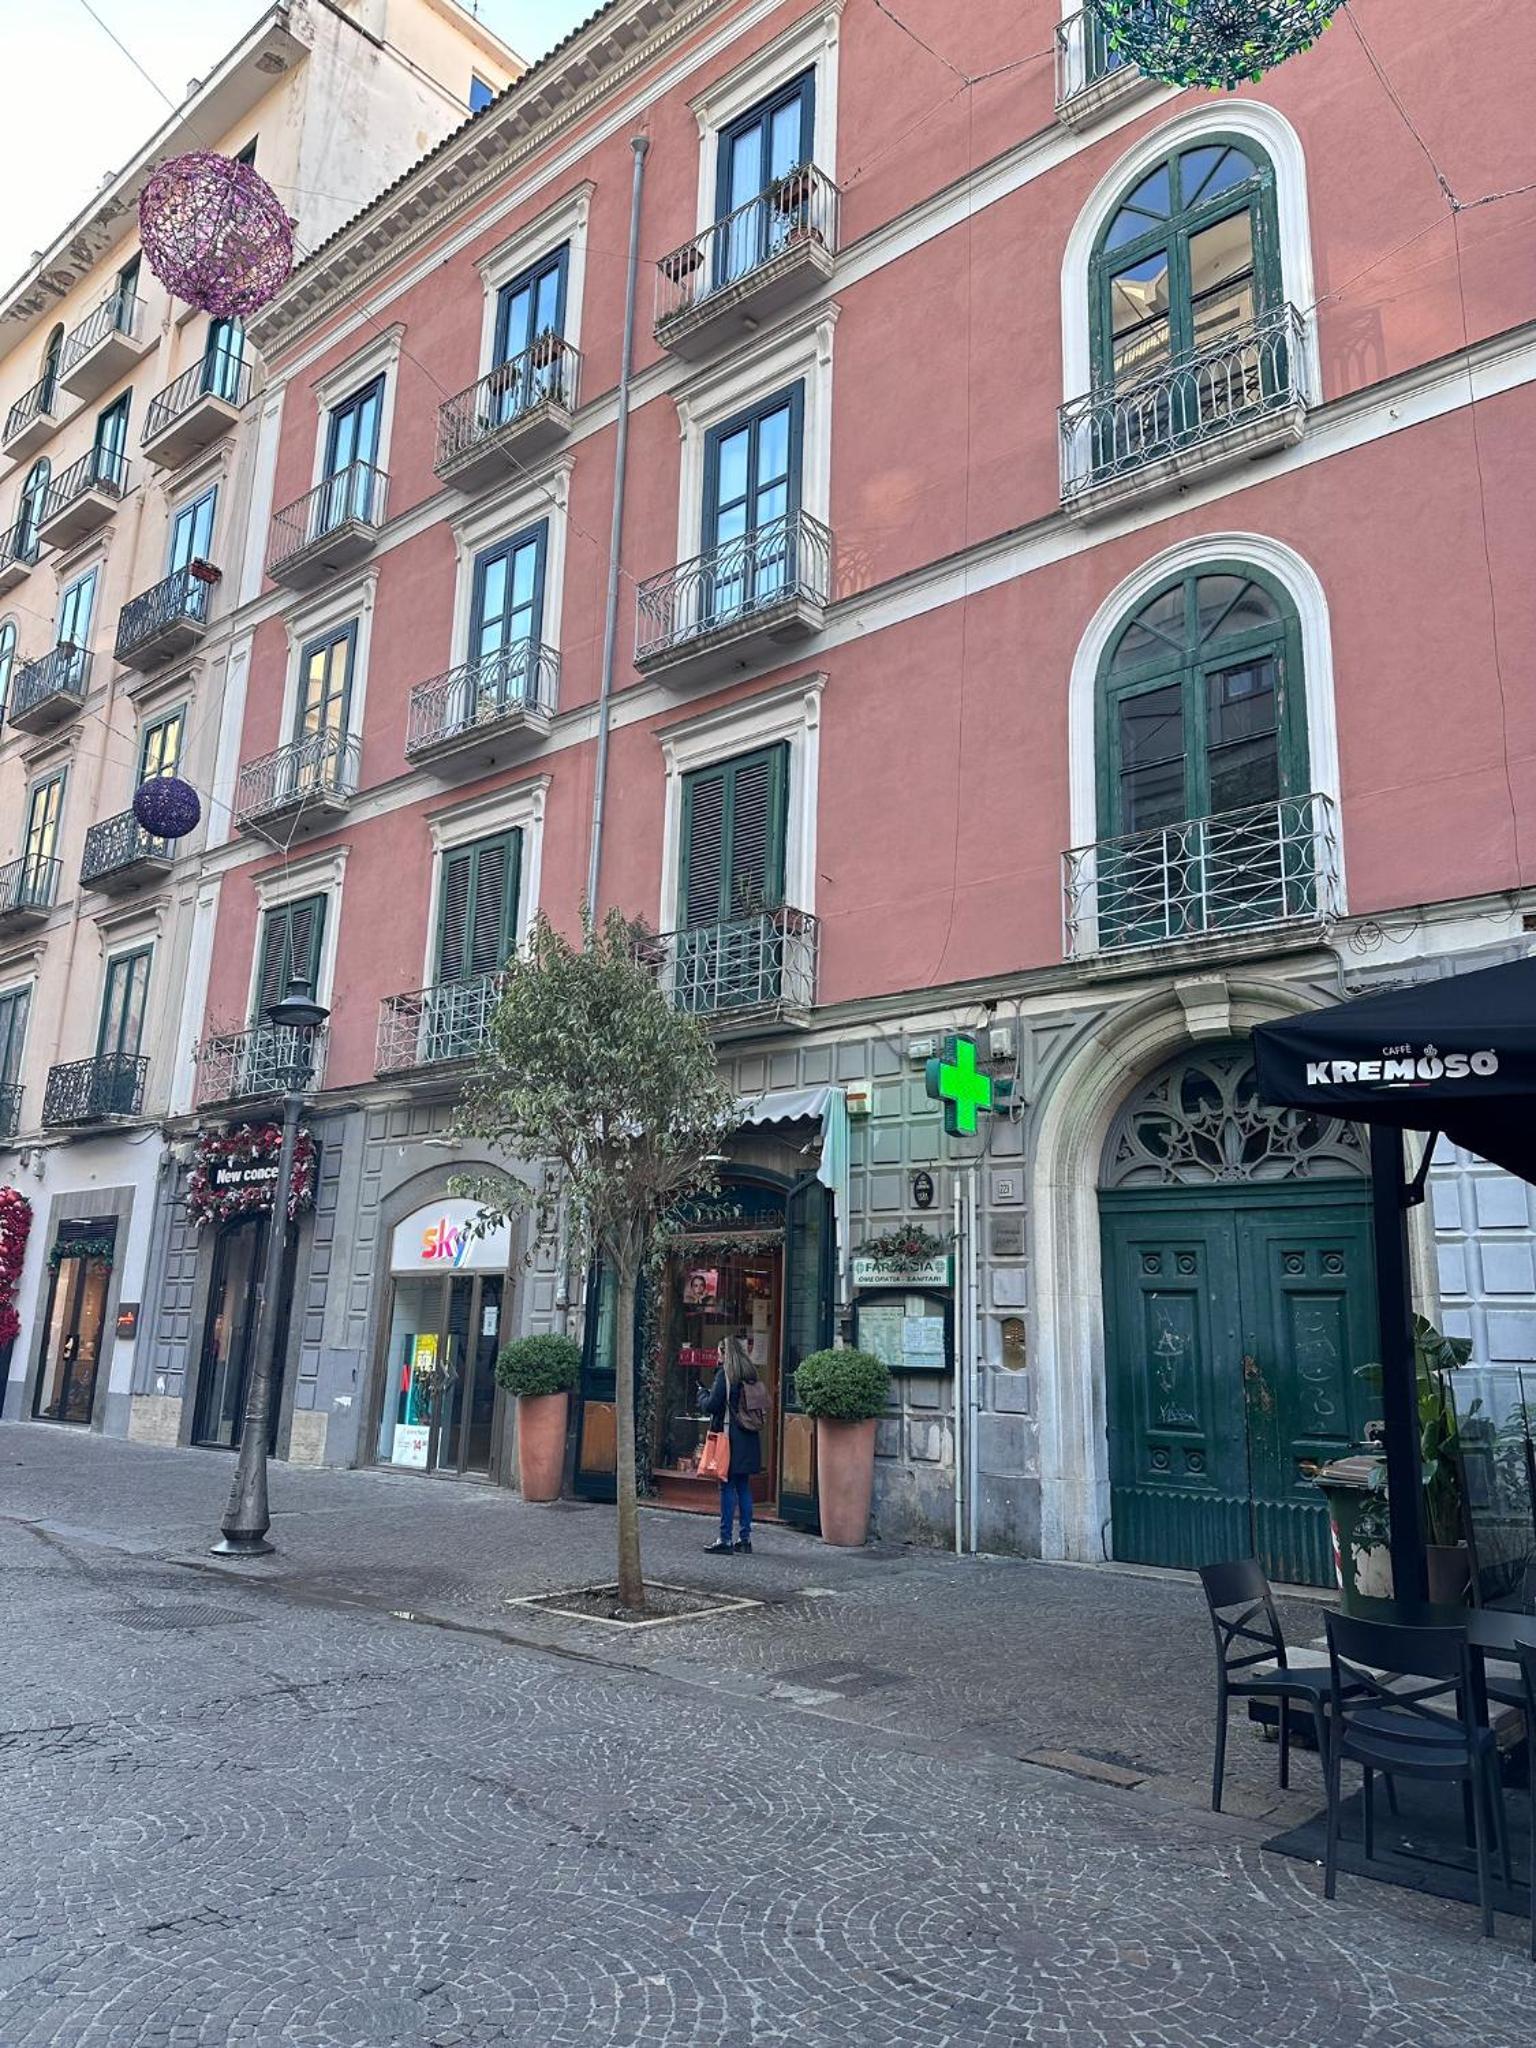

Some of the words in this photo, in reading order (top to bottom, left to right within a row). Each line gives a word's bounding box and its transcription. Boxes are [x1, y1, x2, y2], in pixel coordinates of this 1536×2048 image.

[1382, 1043, 1412, 1056] CAFFÈ
[1306, 1049, 1499, 1085] KREMOSO
[216, 1168, 242, 1184] New
[243, 1166, 280, 1181] conce
[421, 1217, 470, 1267] sky
[865, 1262, 934, 1273] FARCIA
